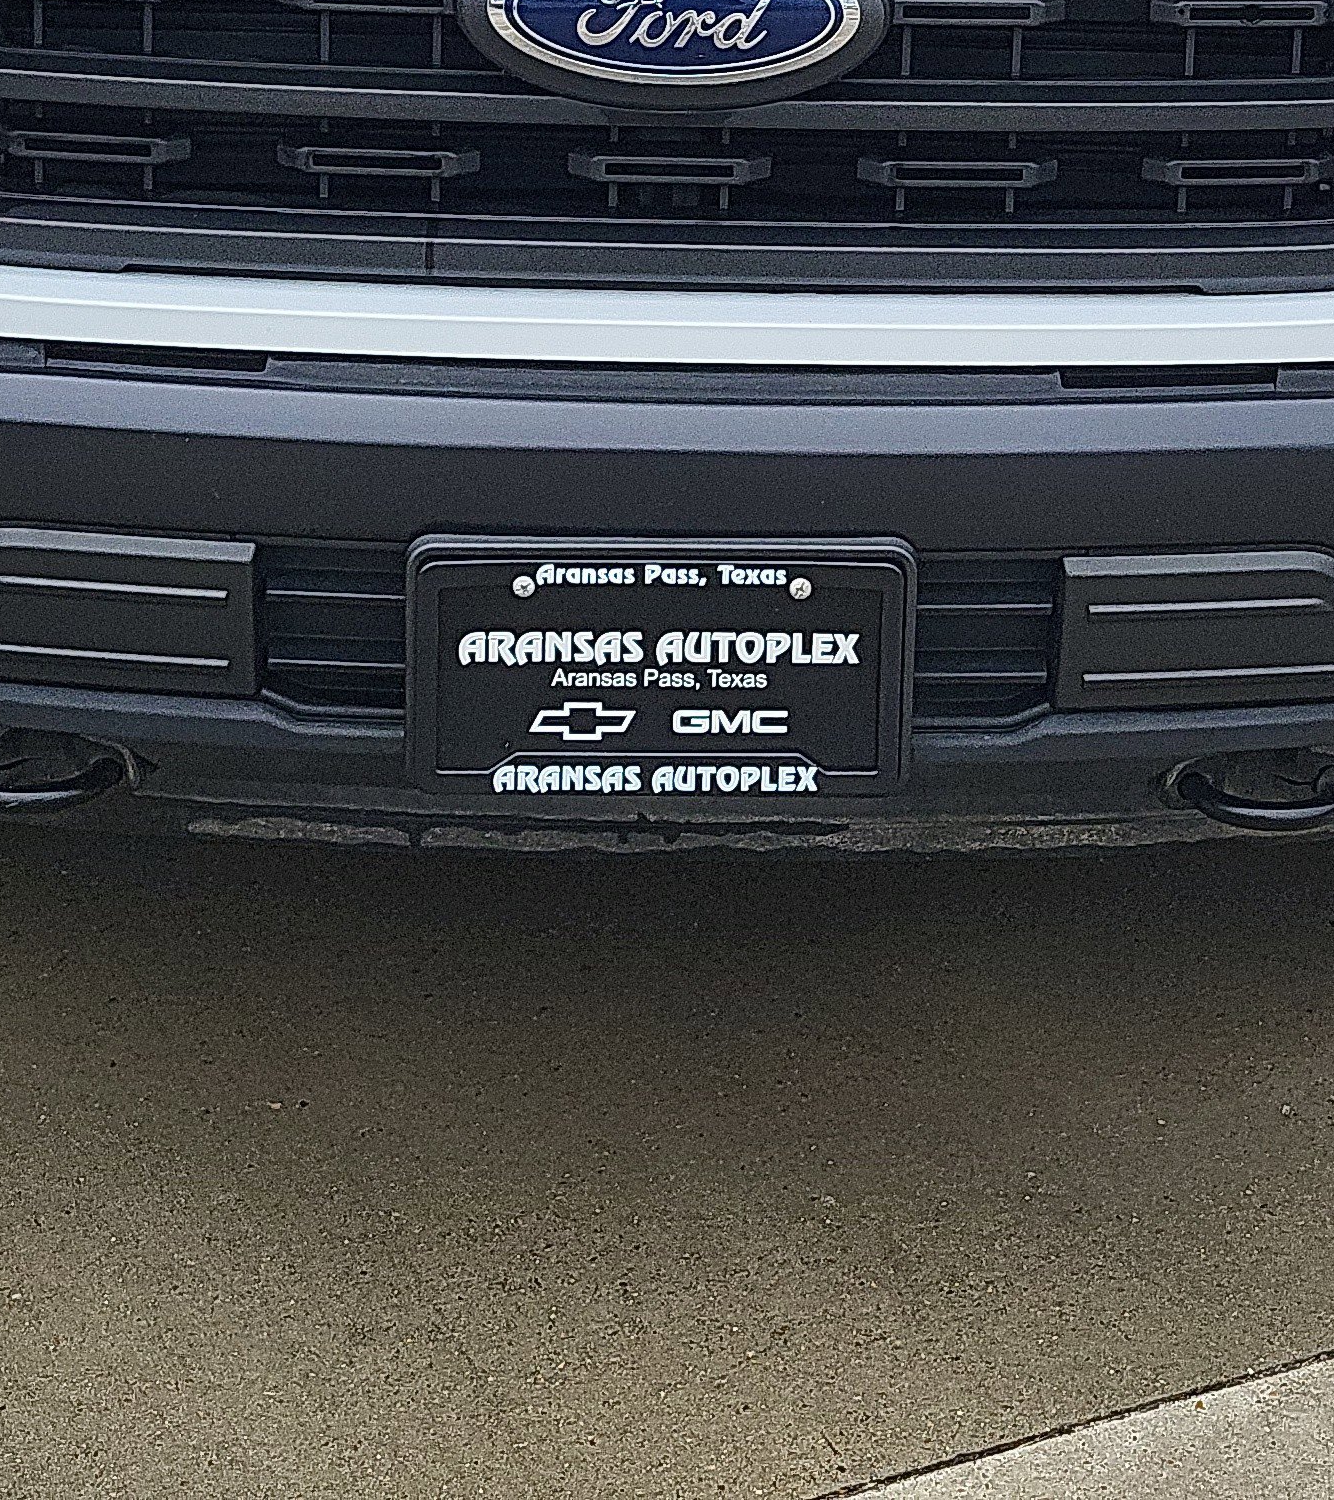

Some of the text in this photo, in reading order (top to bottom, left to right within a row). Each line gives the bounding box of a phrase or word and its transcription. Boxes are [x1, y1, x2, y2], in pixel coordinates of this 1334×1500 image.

[536, 564, 787, 588] Aransas Pass, Texas
[458, 631, 860, 666] ARANSAS AUTOPLEX
[551, 668, 768, 689] Aransas Pass, Texas
[672, 710, 789, 734] GMC
[492, 766, 819, 793] ARANSAS AUTOPLEX
